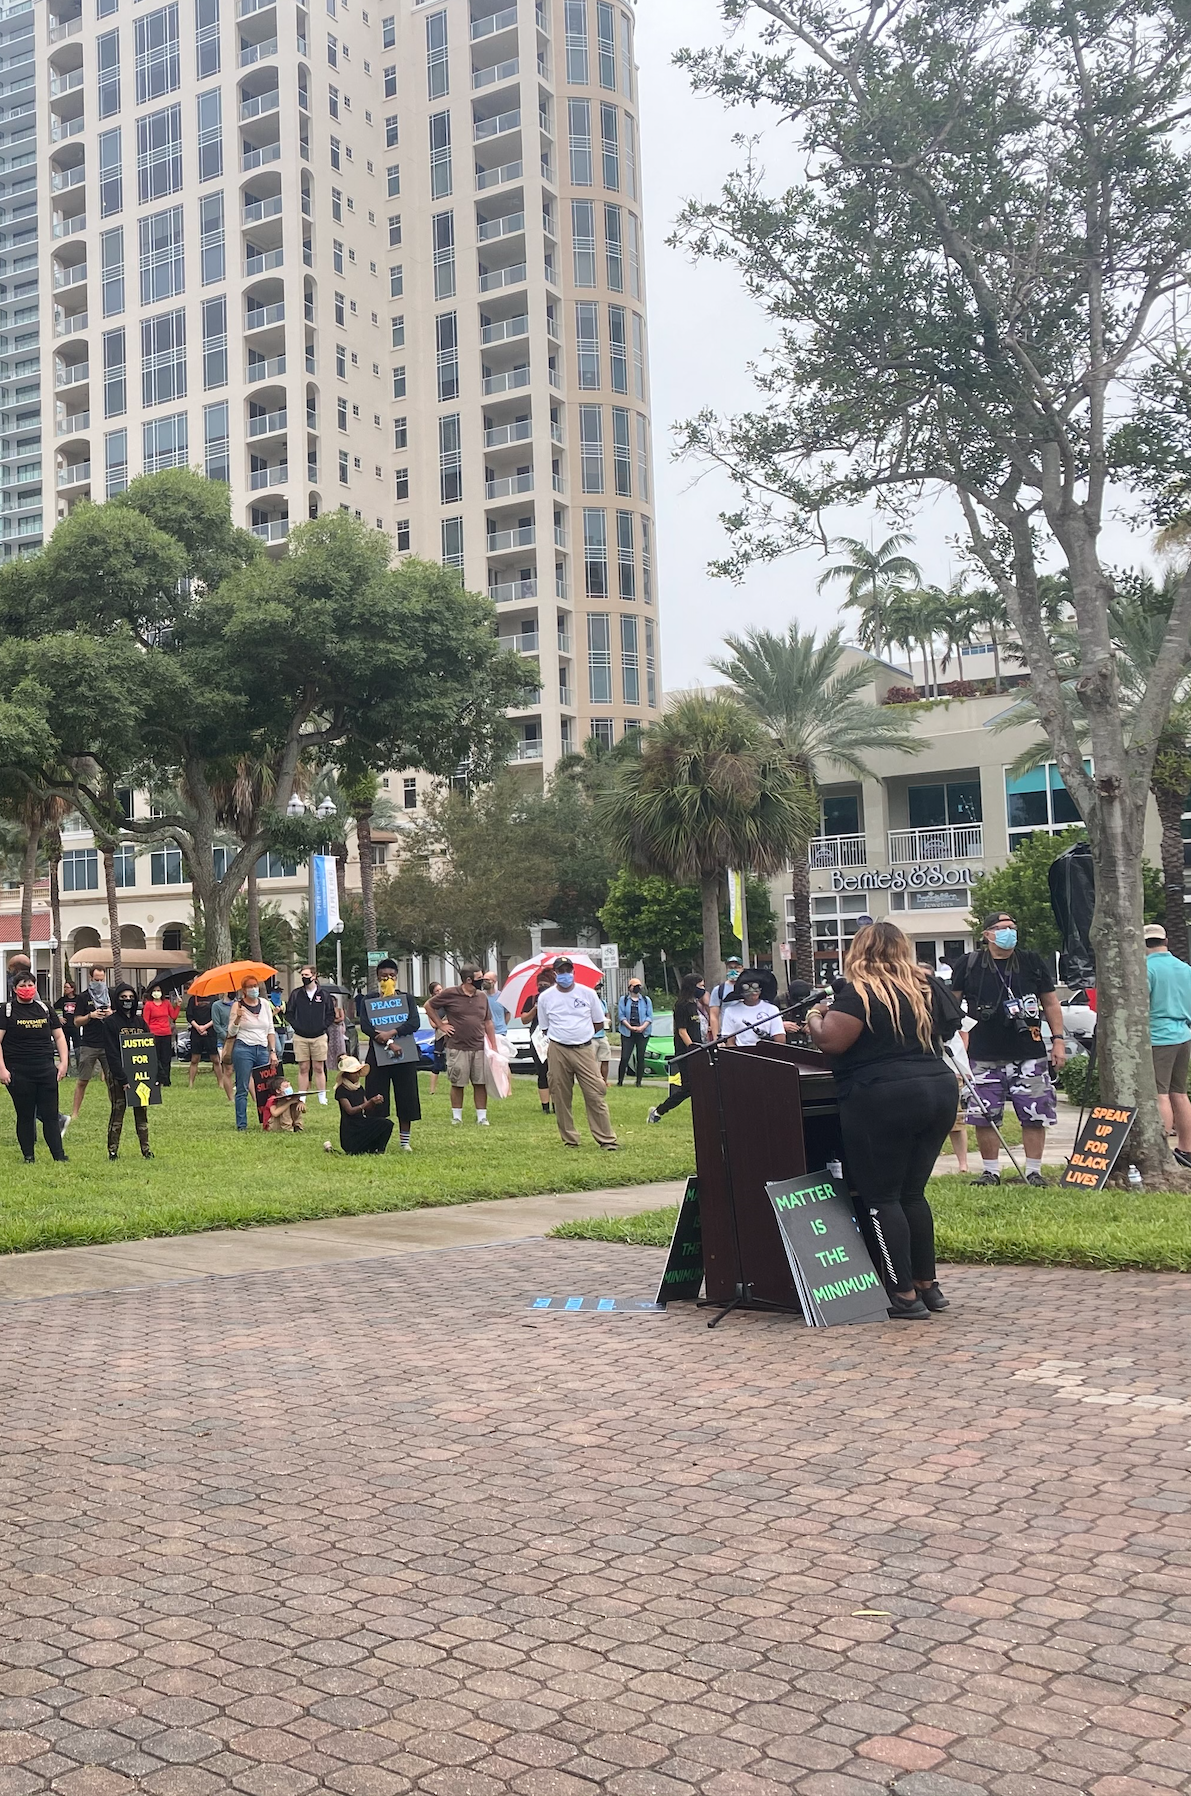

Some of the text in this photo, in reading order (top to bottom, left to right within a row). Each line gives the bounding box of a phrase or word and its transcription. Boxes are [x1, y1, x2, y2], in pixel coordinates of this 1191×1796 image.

[830, 868, 907, 891] Bernie's
[370, 998, 403, 1010] PEACE
[370, 1013, 408, 1026] JUSTICE
[122, 1038, 155, 1048] JUSTICE
[132, 1055, 149, 1064] FOR
[134, 1071, 150, 1081] ALL
[260, 1068, 277, 1079] YOUR
[1091, 1106, 1132, 1123] SPEAK
[1095, 1124, 1113, 1137] UP
[1084, 1140, 1109, 1154] FOR
[1070, 1153, 1111, 1171] BLACK
[1065, 1170, 1099, 1187] LIVES
[775, 1183, 837, 1212] MATTER
[810, 1218, 827, 1236] IS
[682, 1241, 702, 1256] THE
[814, 1246, 849, 1268] THE
[664, 1267, 705, 1284] MINIMUM
[812, 1271, 880, 1304] MINIMUM
